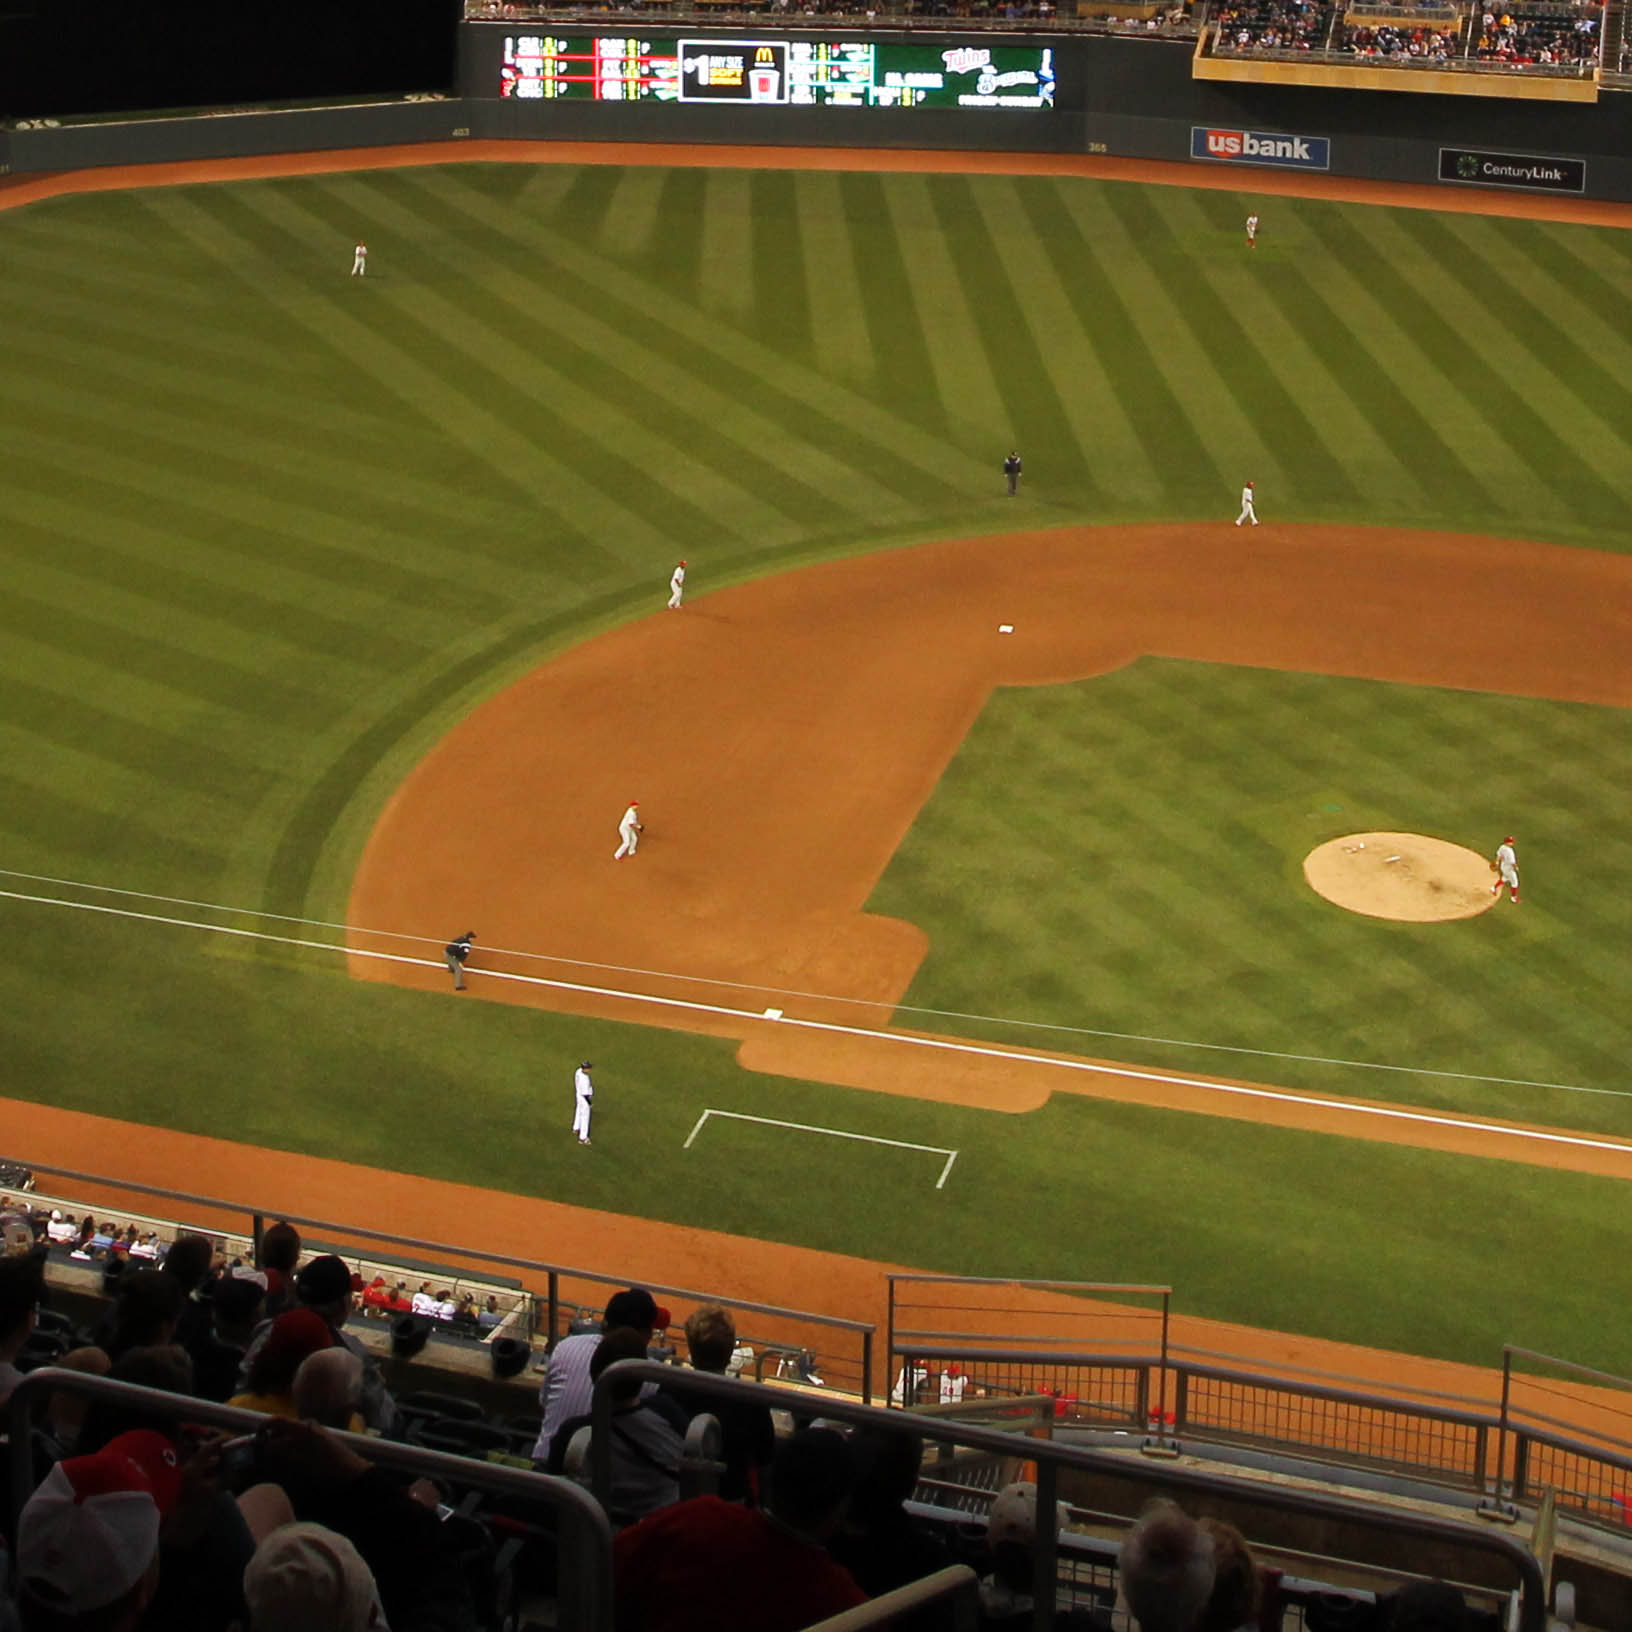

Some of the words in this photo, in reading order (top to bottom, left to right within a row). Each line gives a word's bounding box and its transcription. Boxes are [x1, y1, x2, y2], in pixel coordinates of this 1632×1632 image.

[684, 54, 710, 86] $1
[710, 55, 727, 68] ANY
[728, 55, 744, 68] SIZE
[710, 67, 744, 78] SOFT
[942, 48, 991, 74] Twins
[1208, 131, 1310, 160] usbank
[1482, 161, 1564, 183] CenturyLink
